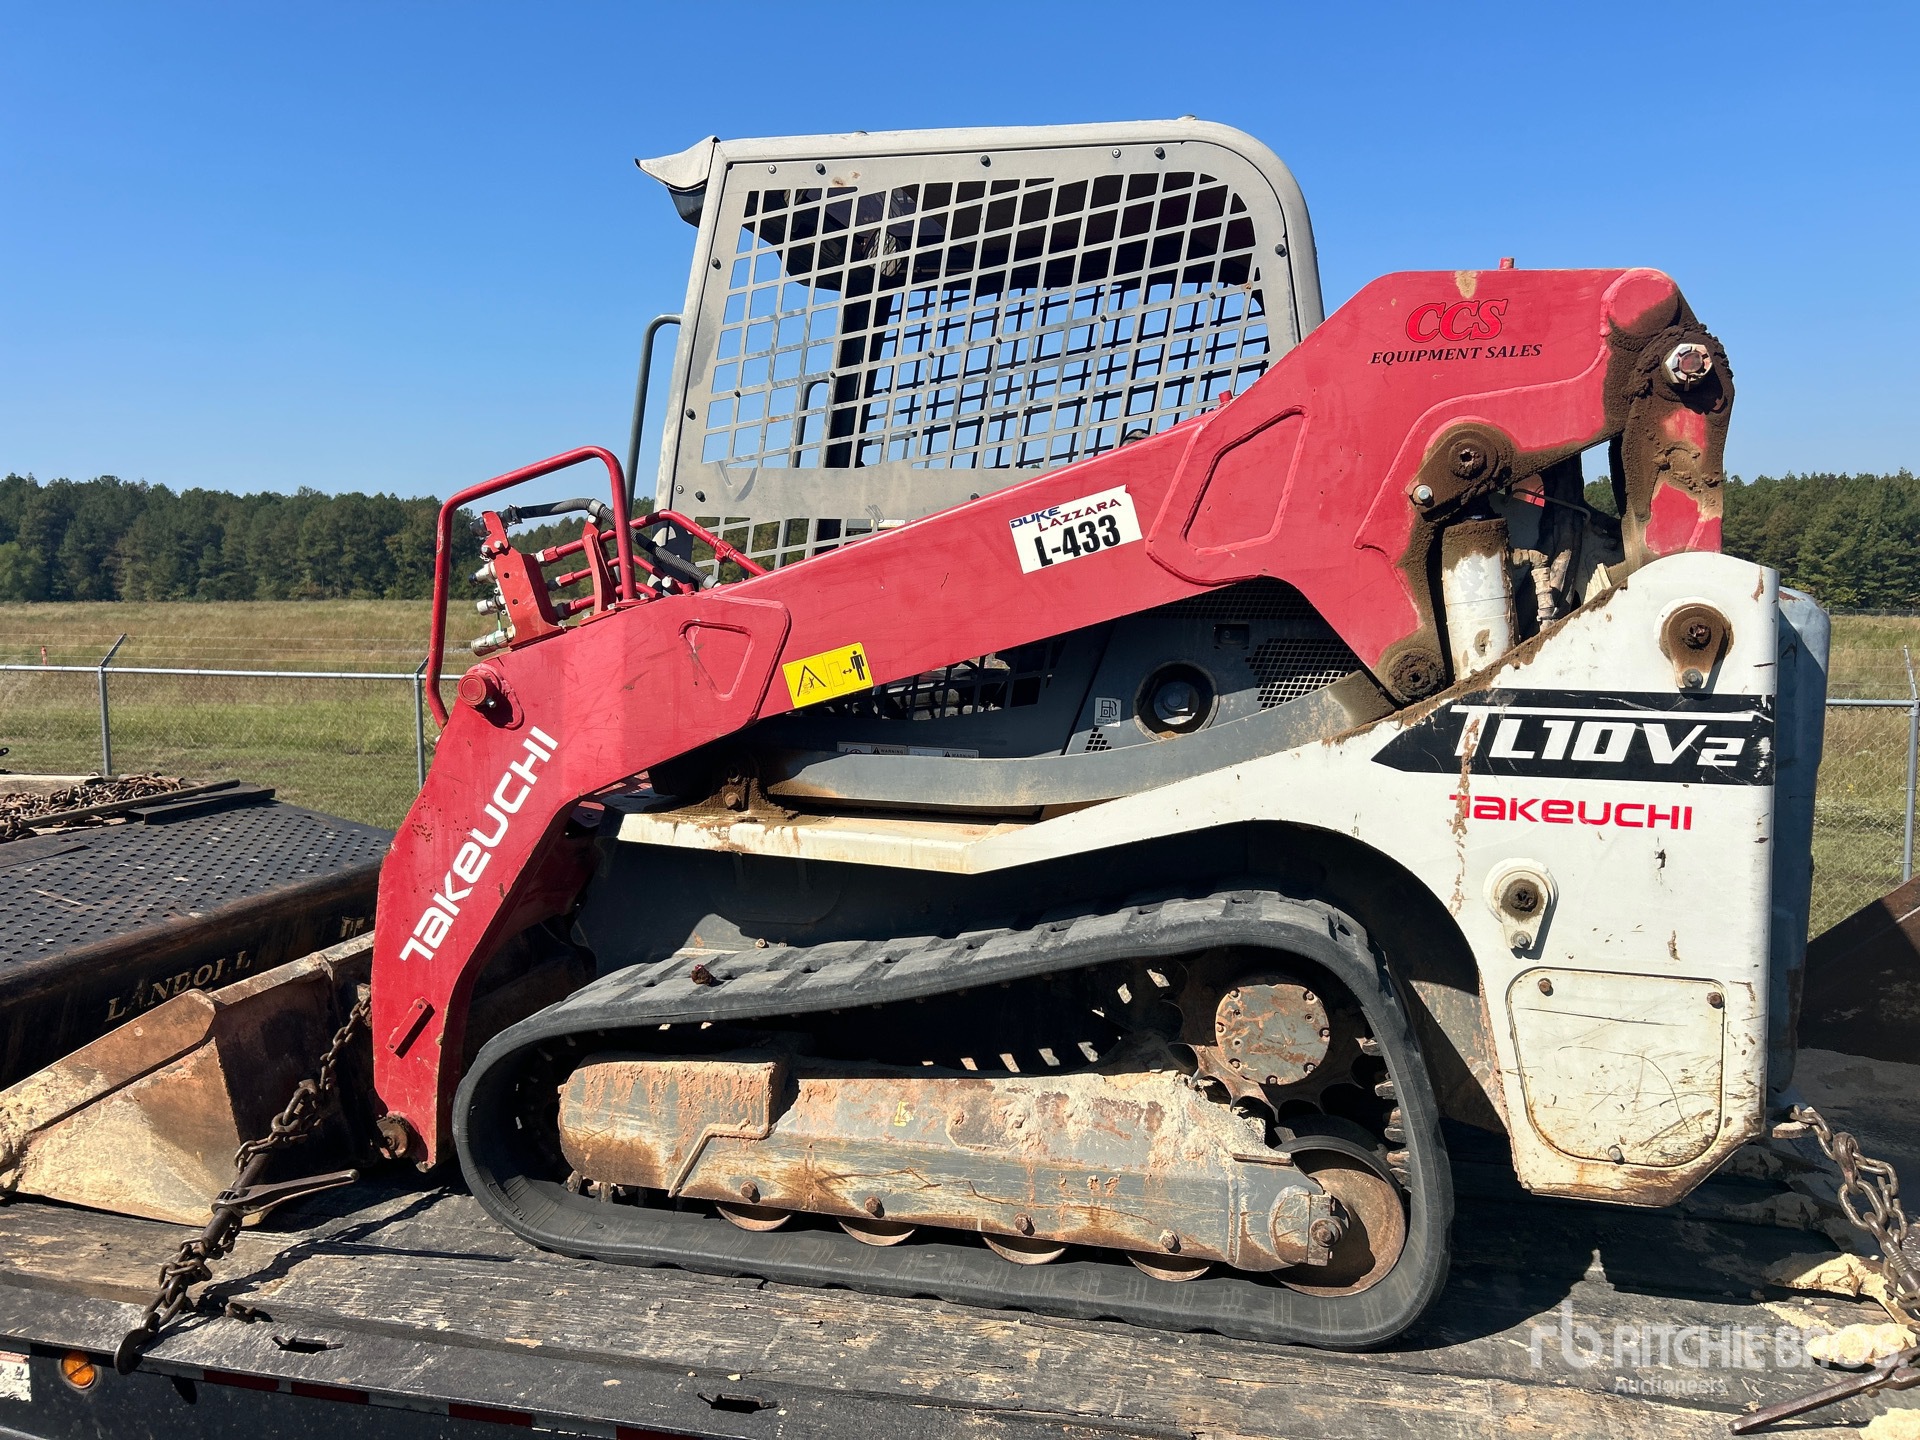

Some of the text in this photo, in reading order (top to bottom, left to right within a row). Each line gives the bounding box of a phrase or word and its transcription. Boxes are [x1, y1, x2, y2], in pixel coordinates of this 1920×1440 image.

[1405, 299, 1508, 343] CCS
[1371, 344, 1543, 365] EQUIPMENT SALES
[1010, 506, 1061, 528] DUKE
[1038, 498, 1122, 532] LAZZARA
[1034, 514, 1121, 567] L-433
[1450, 705, 1754, 767] TL10V2
[399, 725, 559, 961] TAKEUCHI
